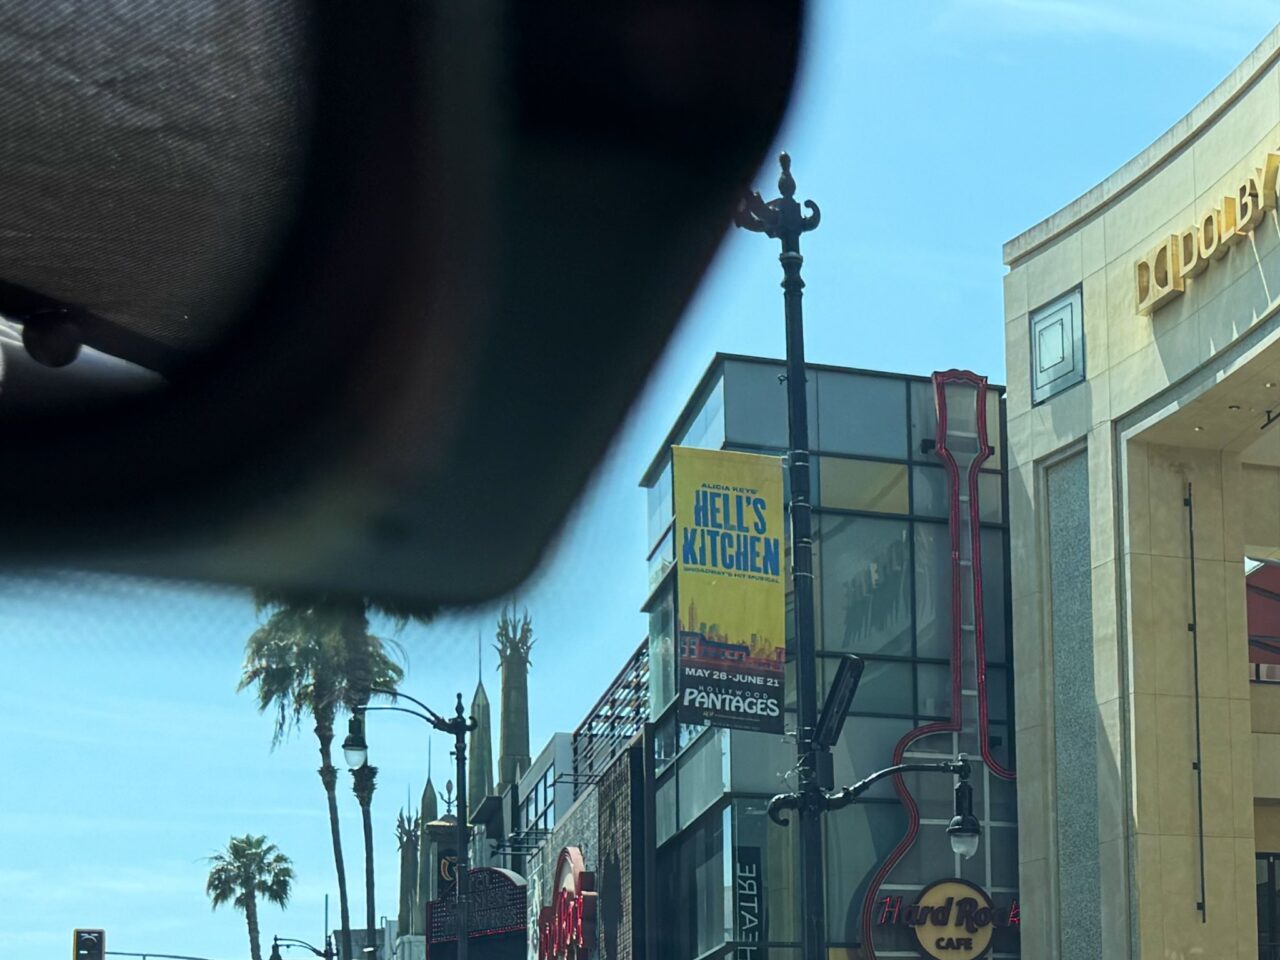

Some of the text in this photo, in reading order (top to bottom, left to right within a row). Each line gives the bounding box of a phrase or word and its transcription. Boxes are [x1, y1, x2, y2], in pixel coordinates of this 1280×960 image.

[701, 483, 730, 491] ALICIA
[694, 490, 766, 534] HELL'S
[683, 527, 779, 576] KITCHEN
[685, 667, 710, 677] MAY
[766, 678, 779, 687] 21
[683, 688, 780, 716] PANTAGES
[699, 685, 768, 698] HOLLYWOOD
[878, 896, 953, 927] Hard
[935, 937, 973, 950] CAFE
